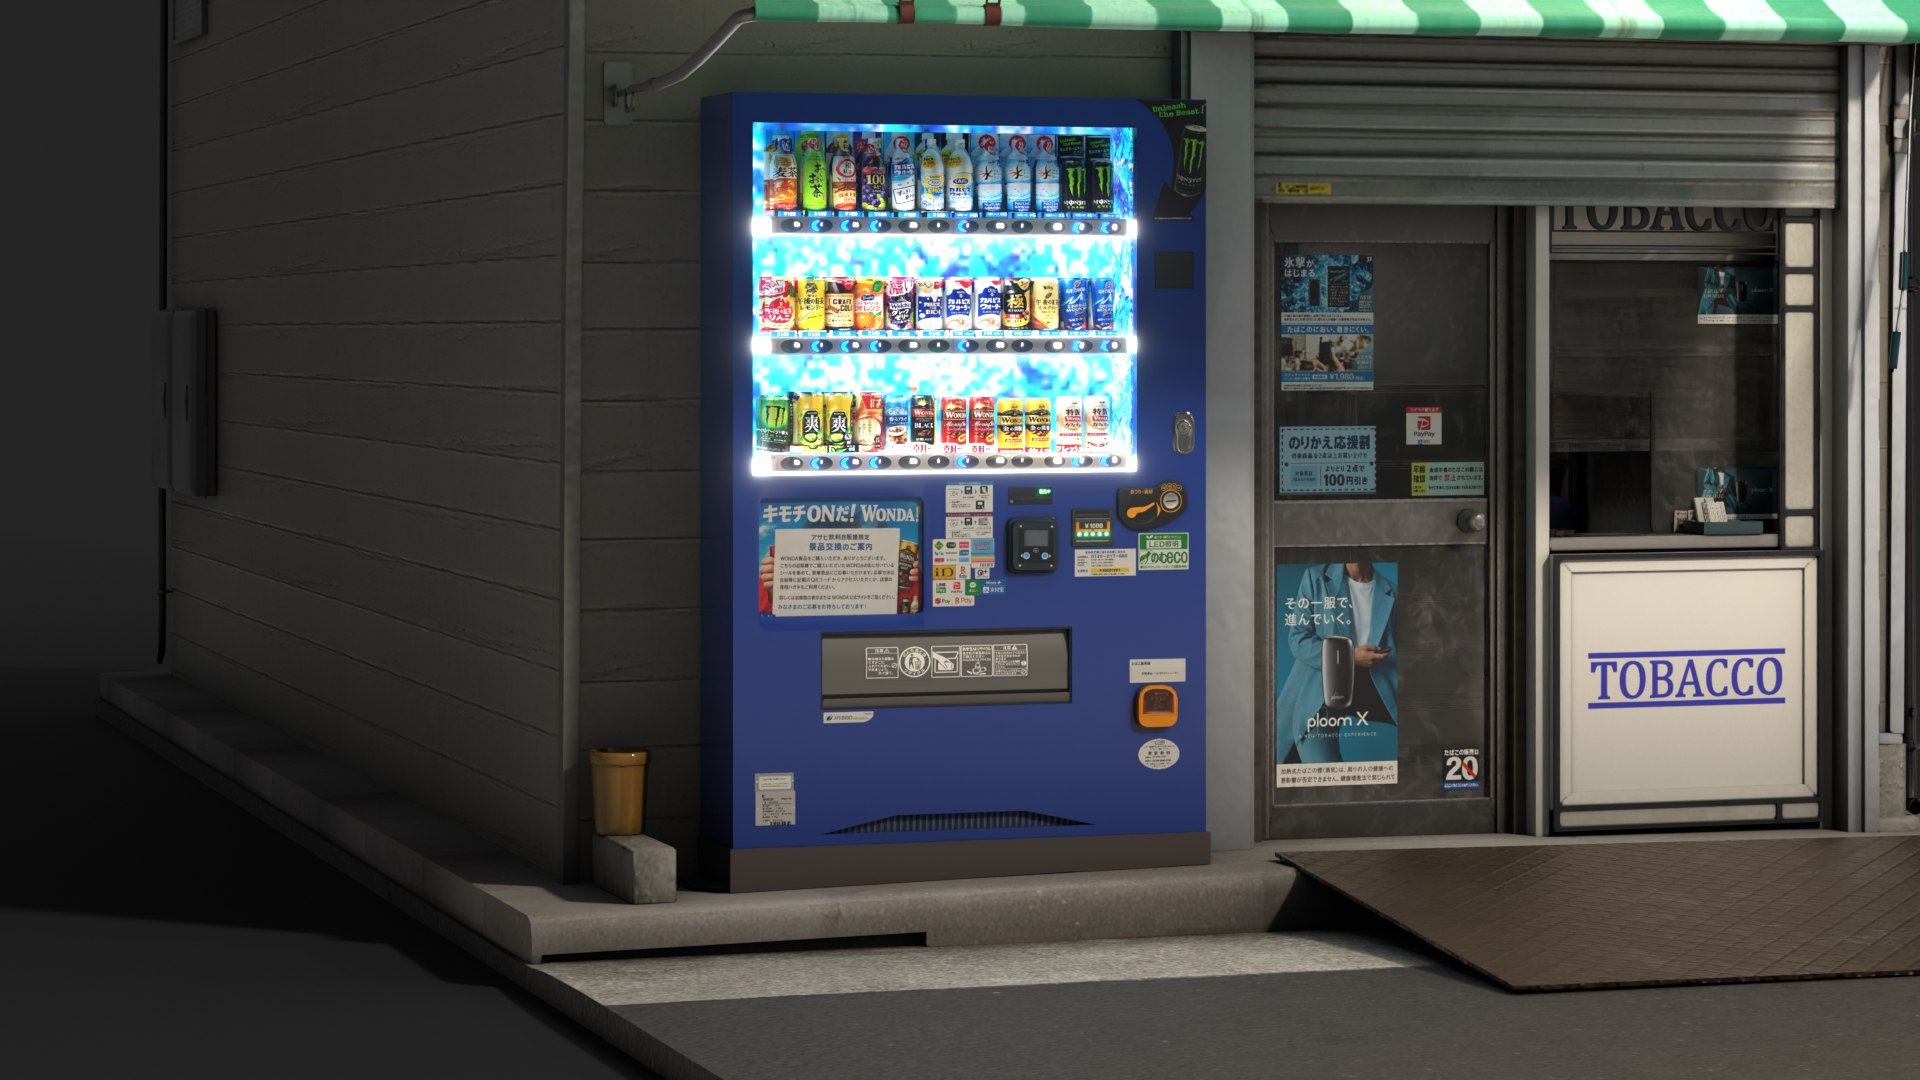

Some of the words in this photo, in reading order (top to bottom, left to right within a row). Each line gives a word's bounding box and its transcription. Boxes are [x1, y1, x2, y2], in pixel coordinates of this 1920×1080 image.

[1151, 102, 1187, 113] Unleash
[1159, 109, 1175, 118] the
[865, 174, 886, 186] 100
[1284, 256, 1315, 268] 氷撃が
[1284, 269, 1316, 277] はじまる
[1288, 434, 1371, 450] のりかえ応援割
[860, 504, 920, 523] WONDA!
[809, 542, 873, 551] 景品交換のご案内
[935, 567, 954, 577] iD
[1284, 597, 1353, 610] その一服で、
[1284, 613, 1352, 626] 進んでいく。
[1590, 657, 1783, 700] TOBACCO
[1307, 712, 1353, 733] ploom
[1356, 711, 1369, 726] X
[1445, 756, 1479, 781] 20
